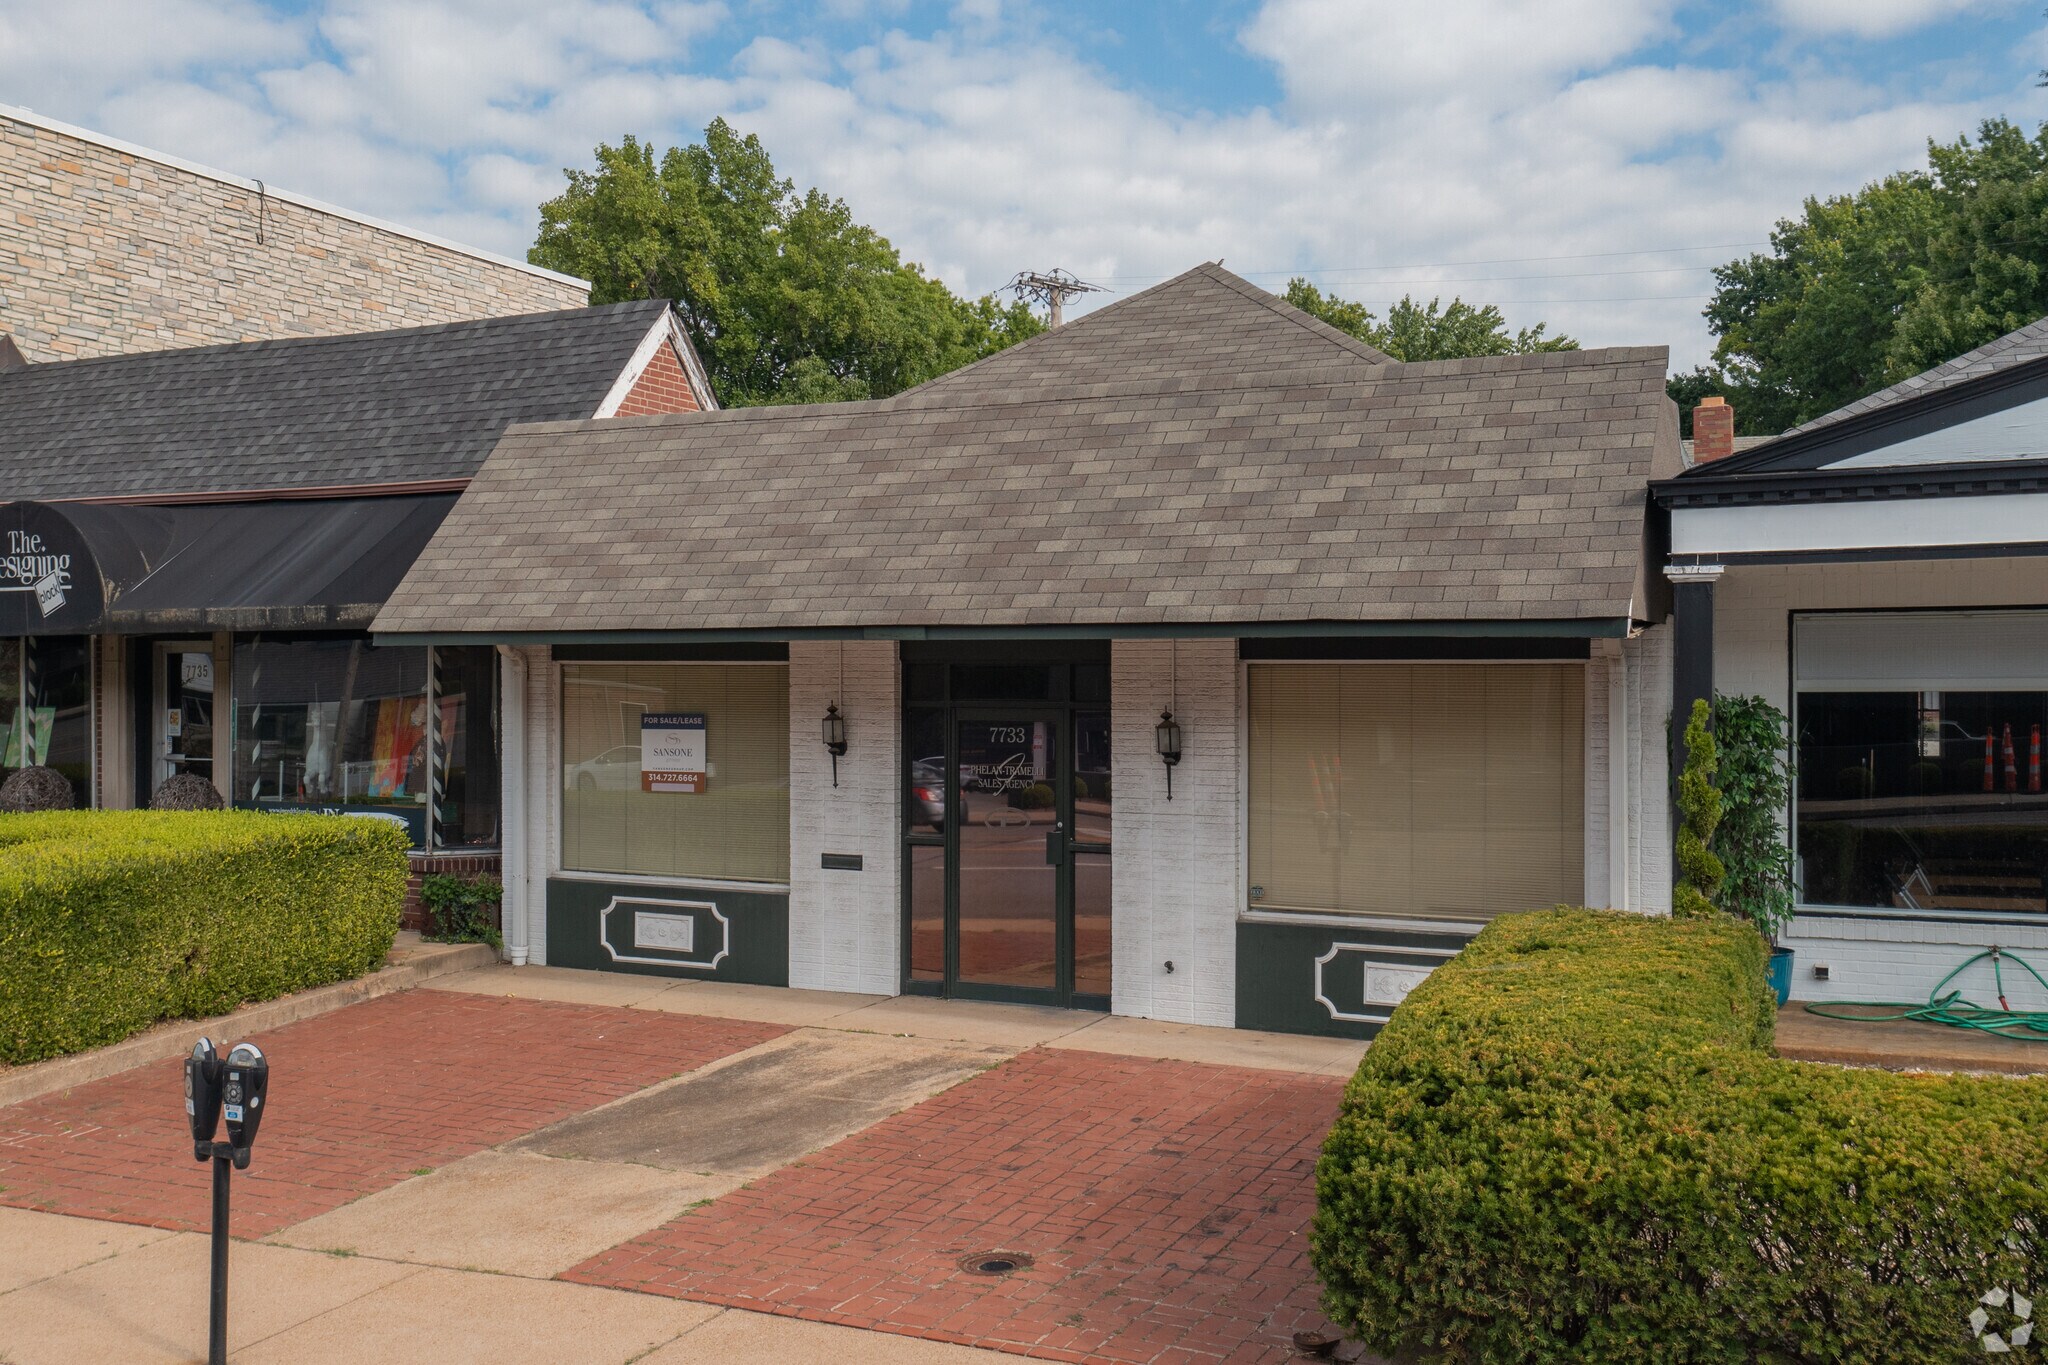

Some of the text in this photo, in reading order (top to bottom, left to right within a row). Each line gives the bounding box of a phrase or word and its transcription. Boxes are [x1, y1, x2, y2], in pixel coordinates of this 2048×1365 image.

[186, 664, 208, 678] 7735
[660, 717, 702, 725] SALE/LEASE
[989, 727, 1025, 743] 7733
[653, 747, 693, 758] SANSONE
[648, 773, 698, 782] 314.727.6664
[978, 778, 1036, 789] SALES AGENCY
